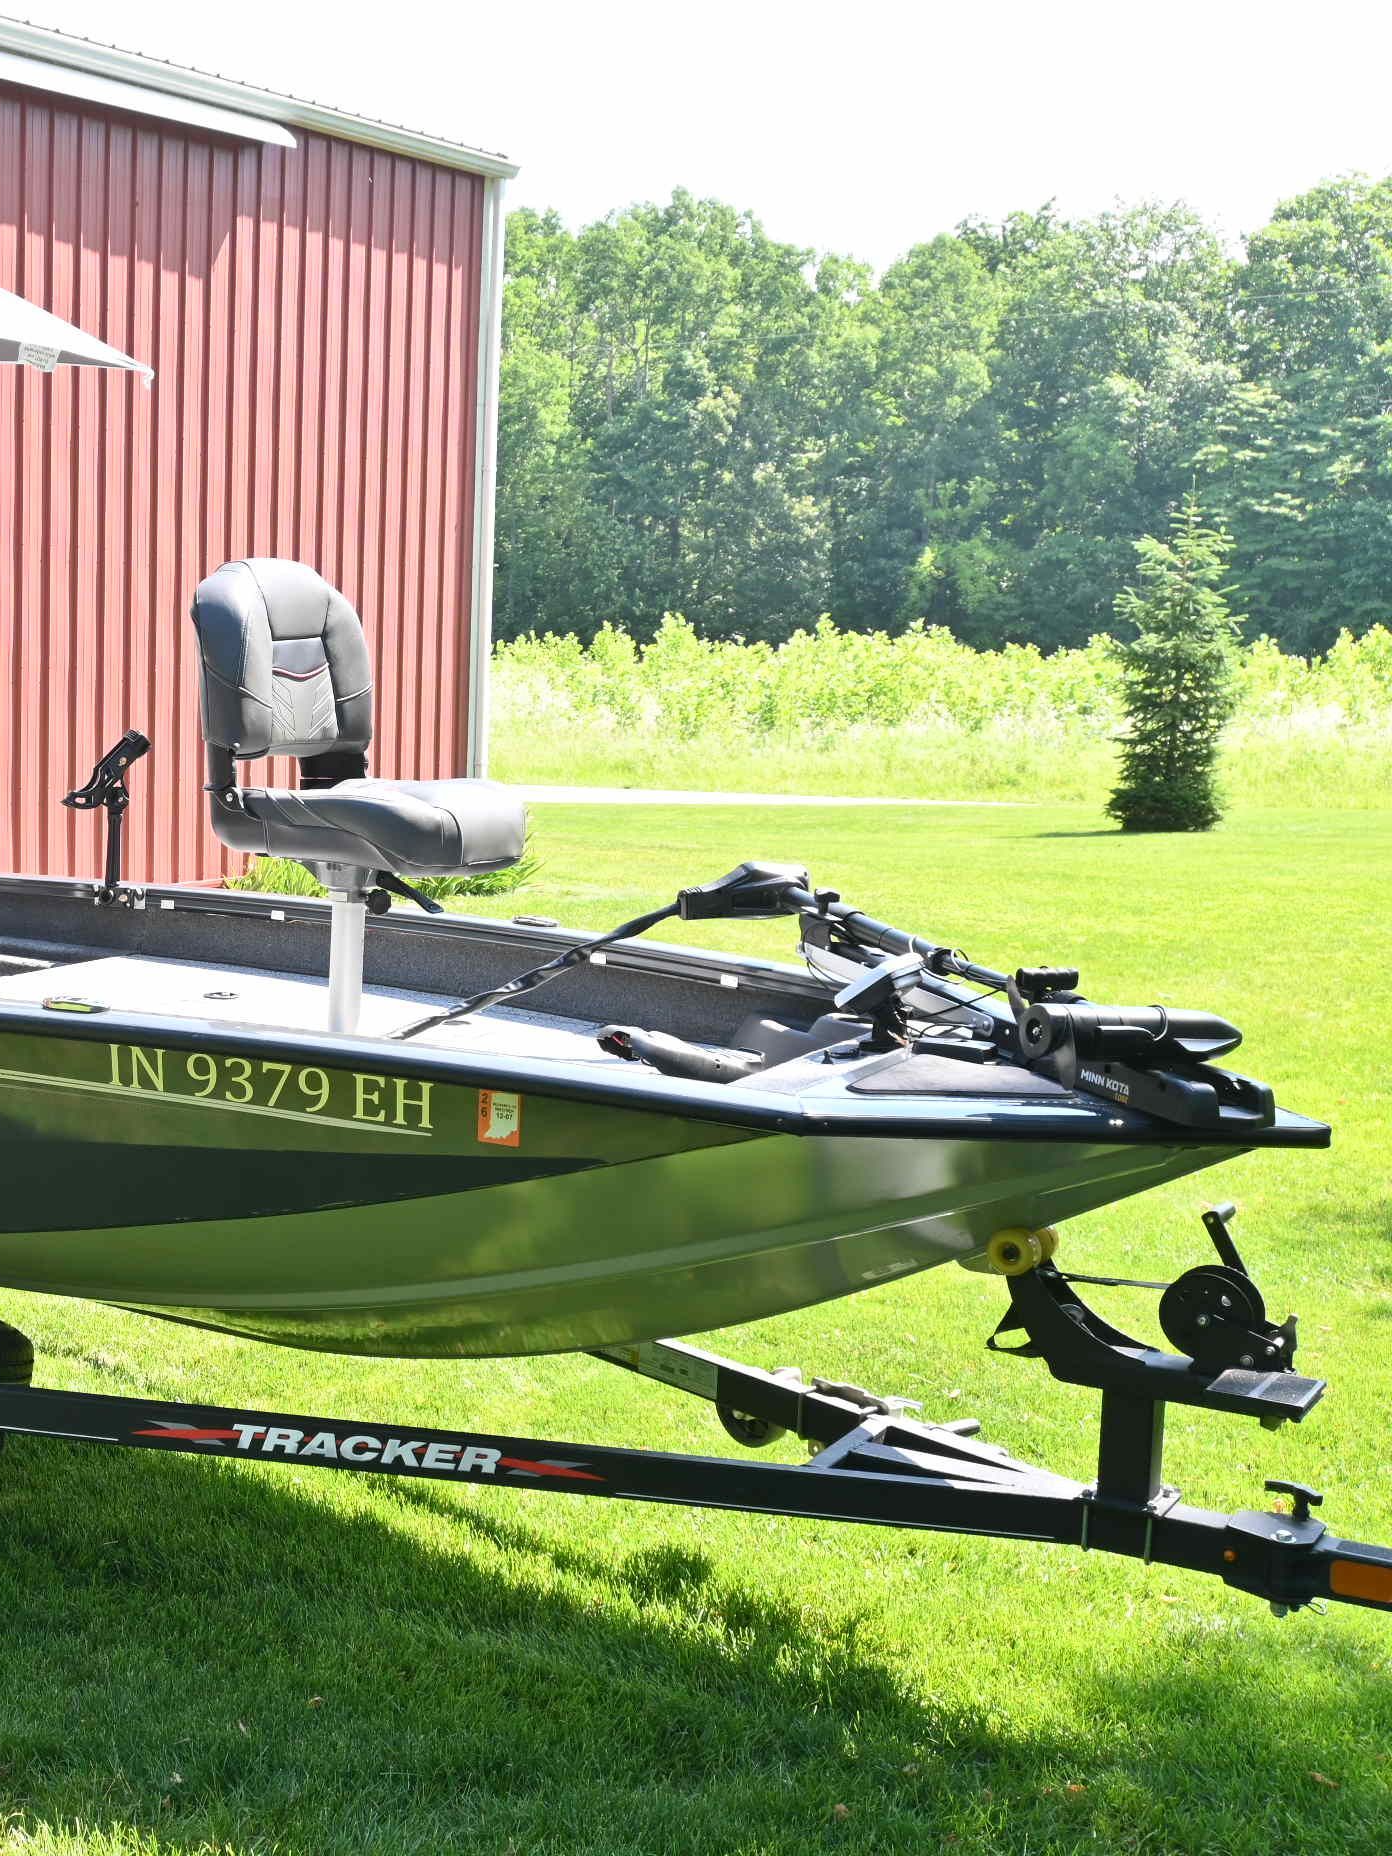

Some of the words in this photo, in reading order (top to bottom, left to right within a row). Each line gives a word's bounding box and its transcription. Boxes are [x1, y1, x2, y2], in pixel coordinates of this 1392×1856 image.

[109, 1043, 166, 1093] IN
[186, 1053, 330, 1112] 9379
[352, 1073, 435, 1129] EH
[1080, 1068, 1105, 1087] MINN
[1106, 1078, 1130, 1096] KOTA
[232, 1423, 503, 1475] TRACKER
